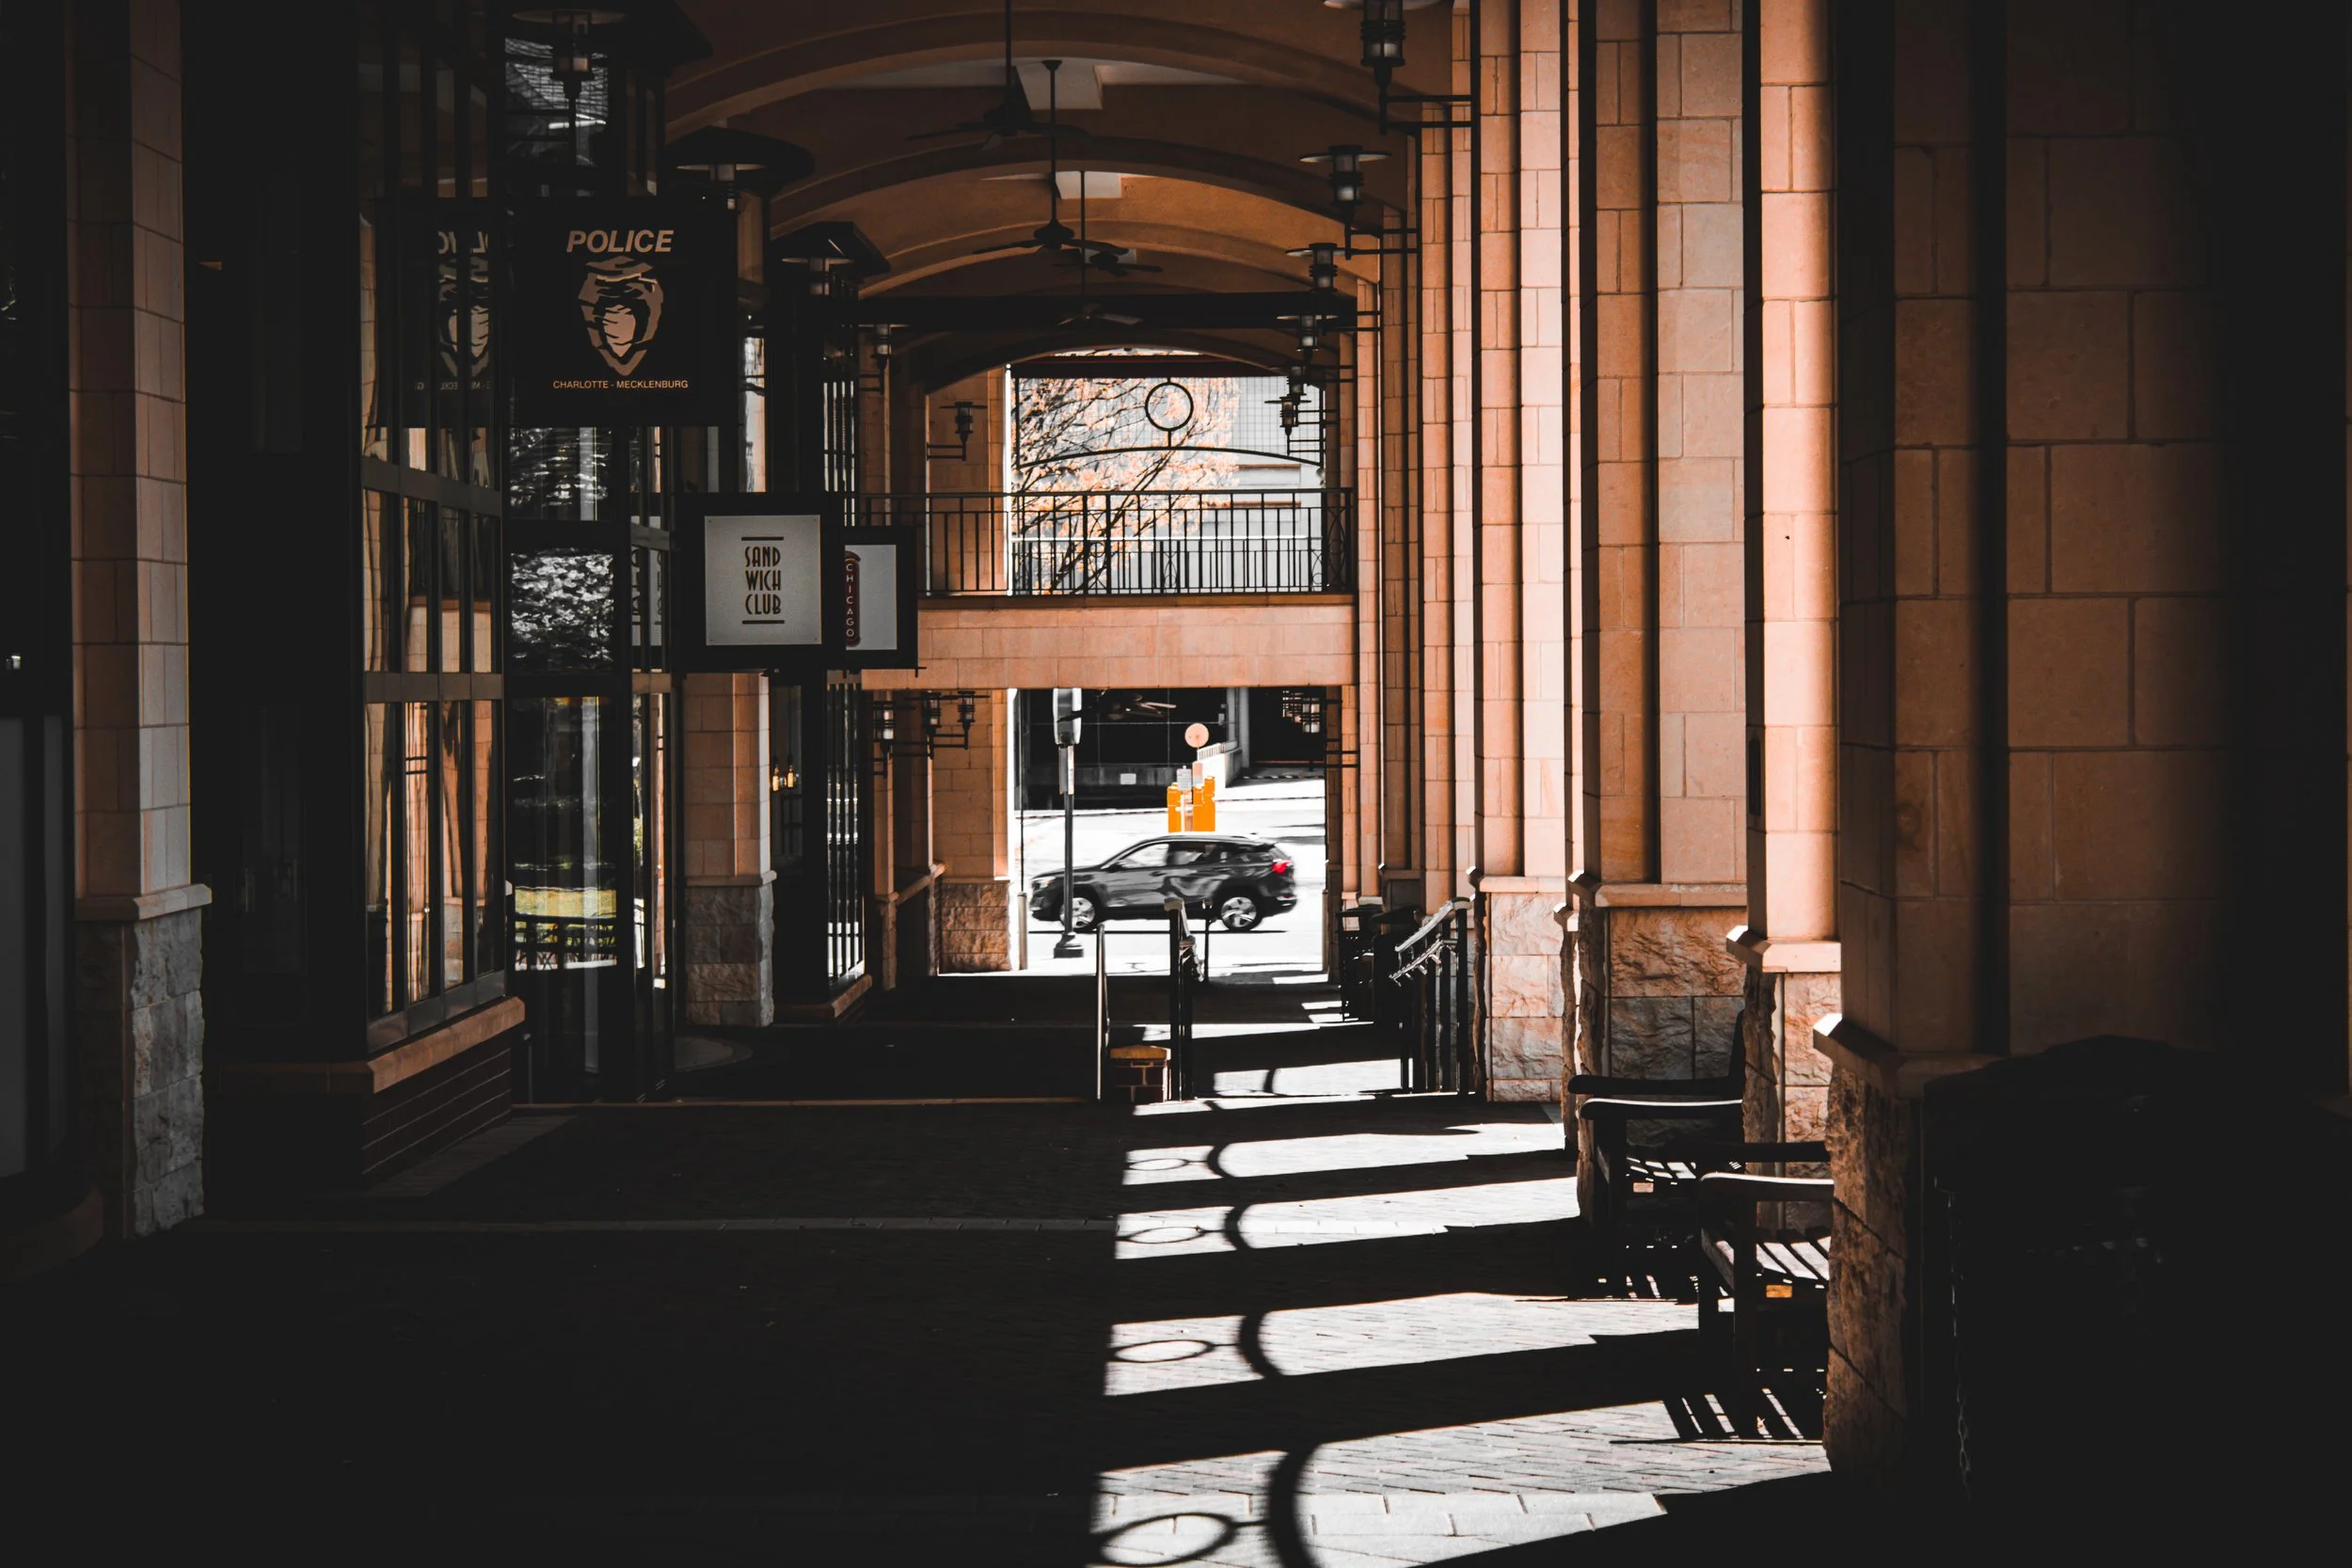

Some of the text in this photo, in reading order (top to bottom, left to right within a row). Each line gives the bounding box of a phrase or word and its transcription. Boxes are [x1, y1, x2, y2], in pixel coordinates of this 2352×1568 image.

[565, 230, 675, 253] POLICE
[552, 380, 609, 389] CHARLOTTE
[616, 379, 689, 388] MECKLENBURG
[744, 546, 782, 568] SAND
[744, 569, 782, 592] WICH
[744, 594, 782, 615] CLUB
[845, 562, 855, 638] CHICAGO
